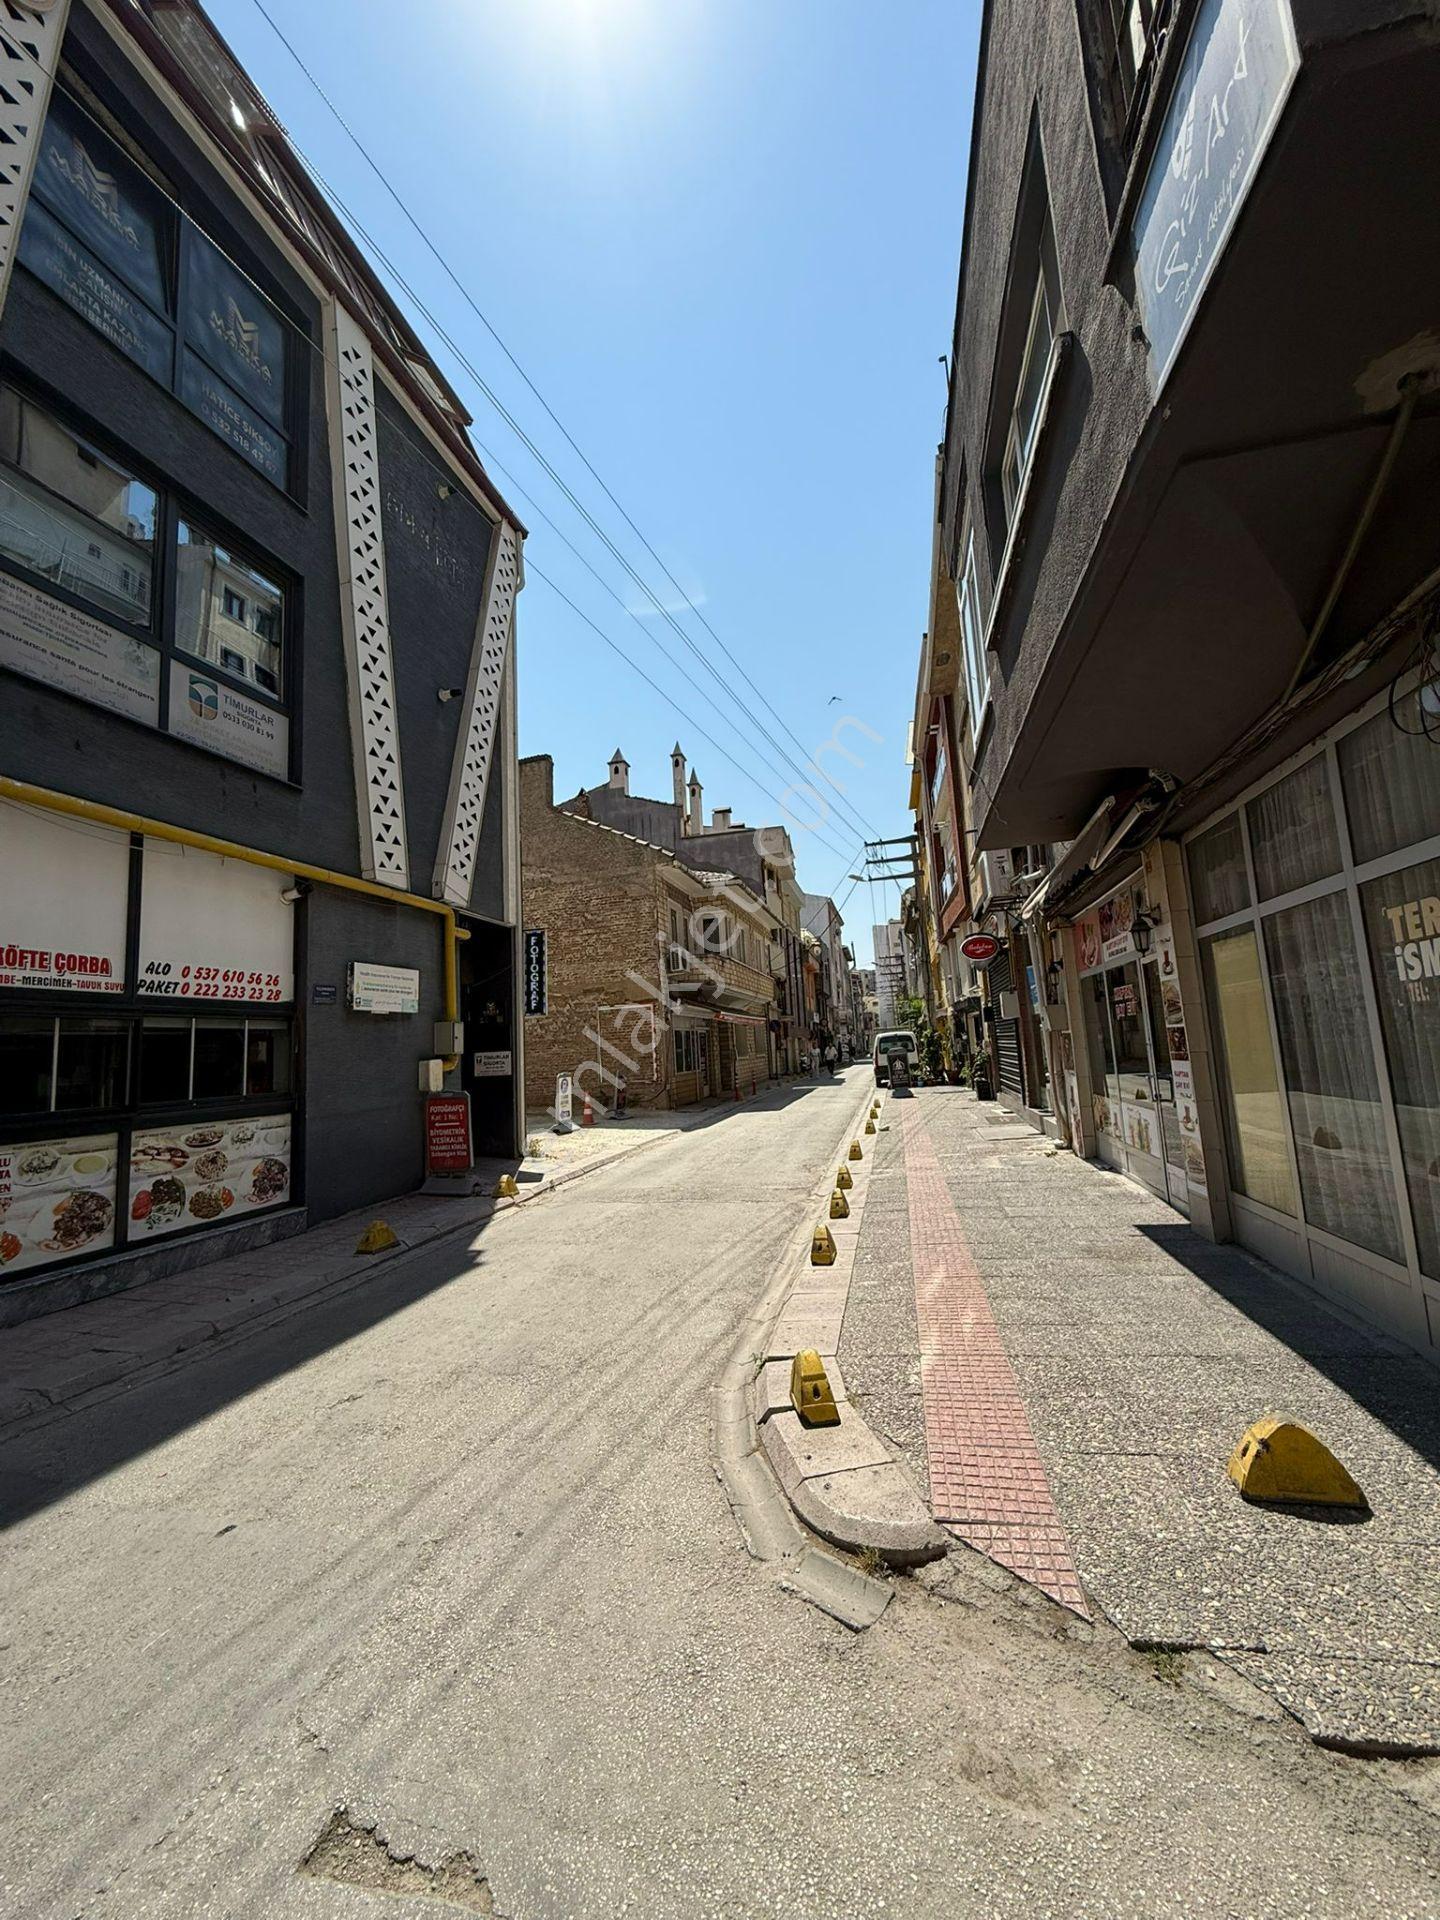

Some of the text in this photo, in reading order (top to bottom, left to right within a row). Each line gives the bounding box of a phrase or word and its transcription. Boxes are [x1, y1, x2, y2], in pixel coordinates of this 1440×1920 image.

[223, 693, 275, 727] TİMURLAR
[54, 952, 113, 977] ÇORBA
[145, 961, 281, 987] ALO 0 537 610 56 26
[137, 979, 282, 1002] PAKET 0 222 233 23 28
